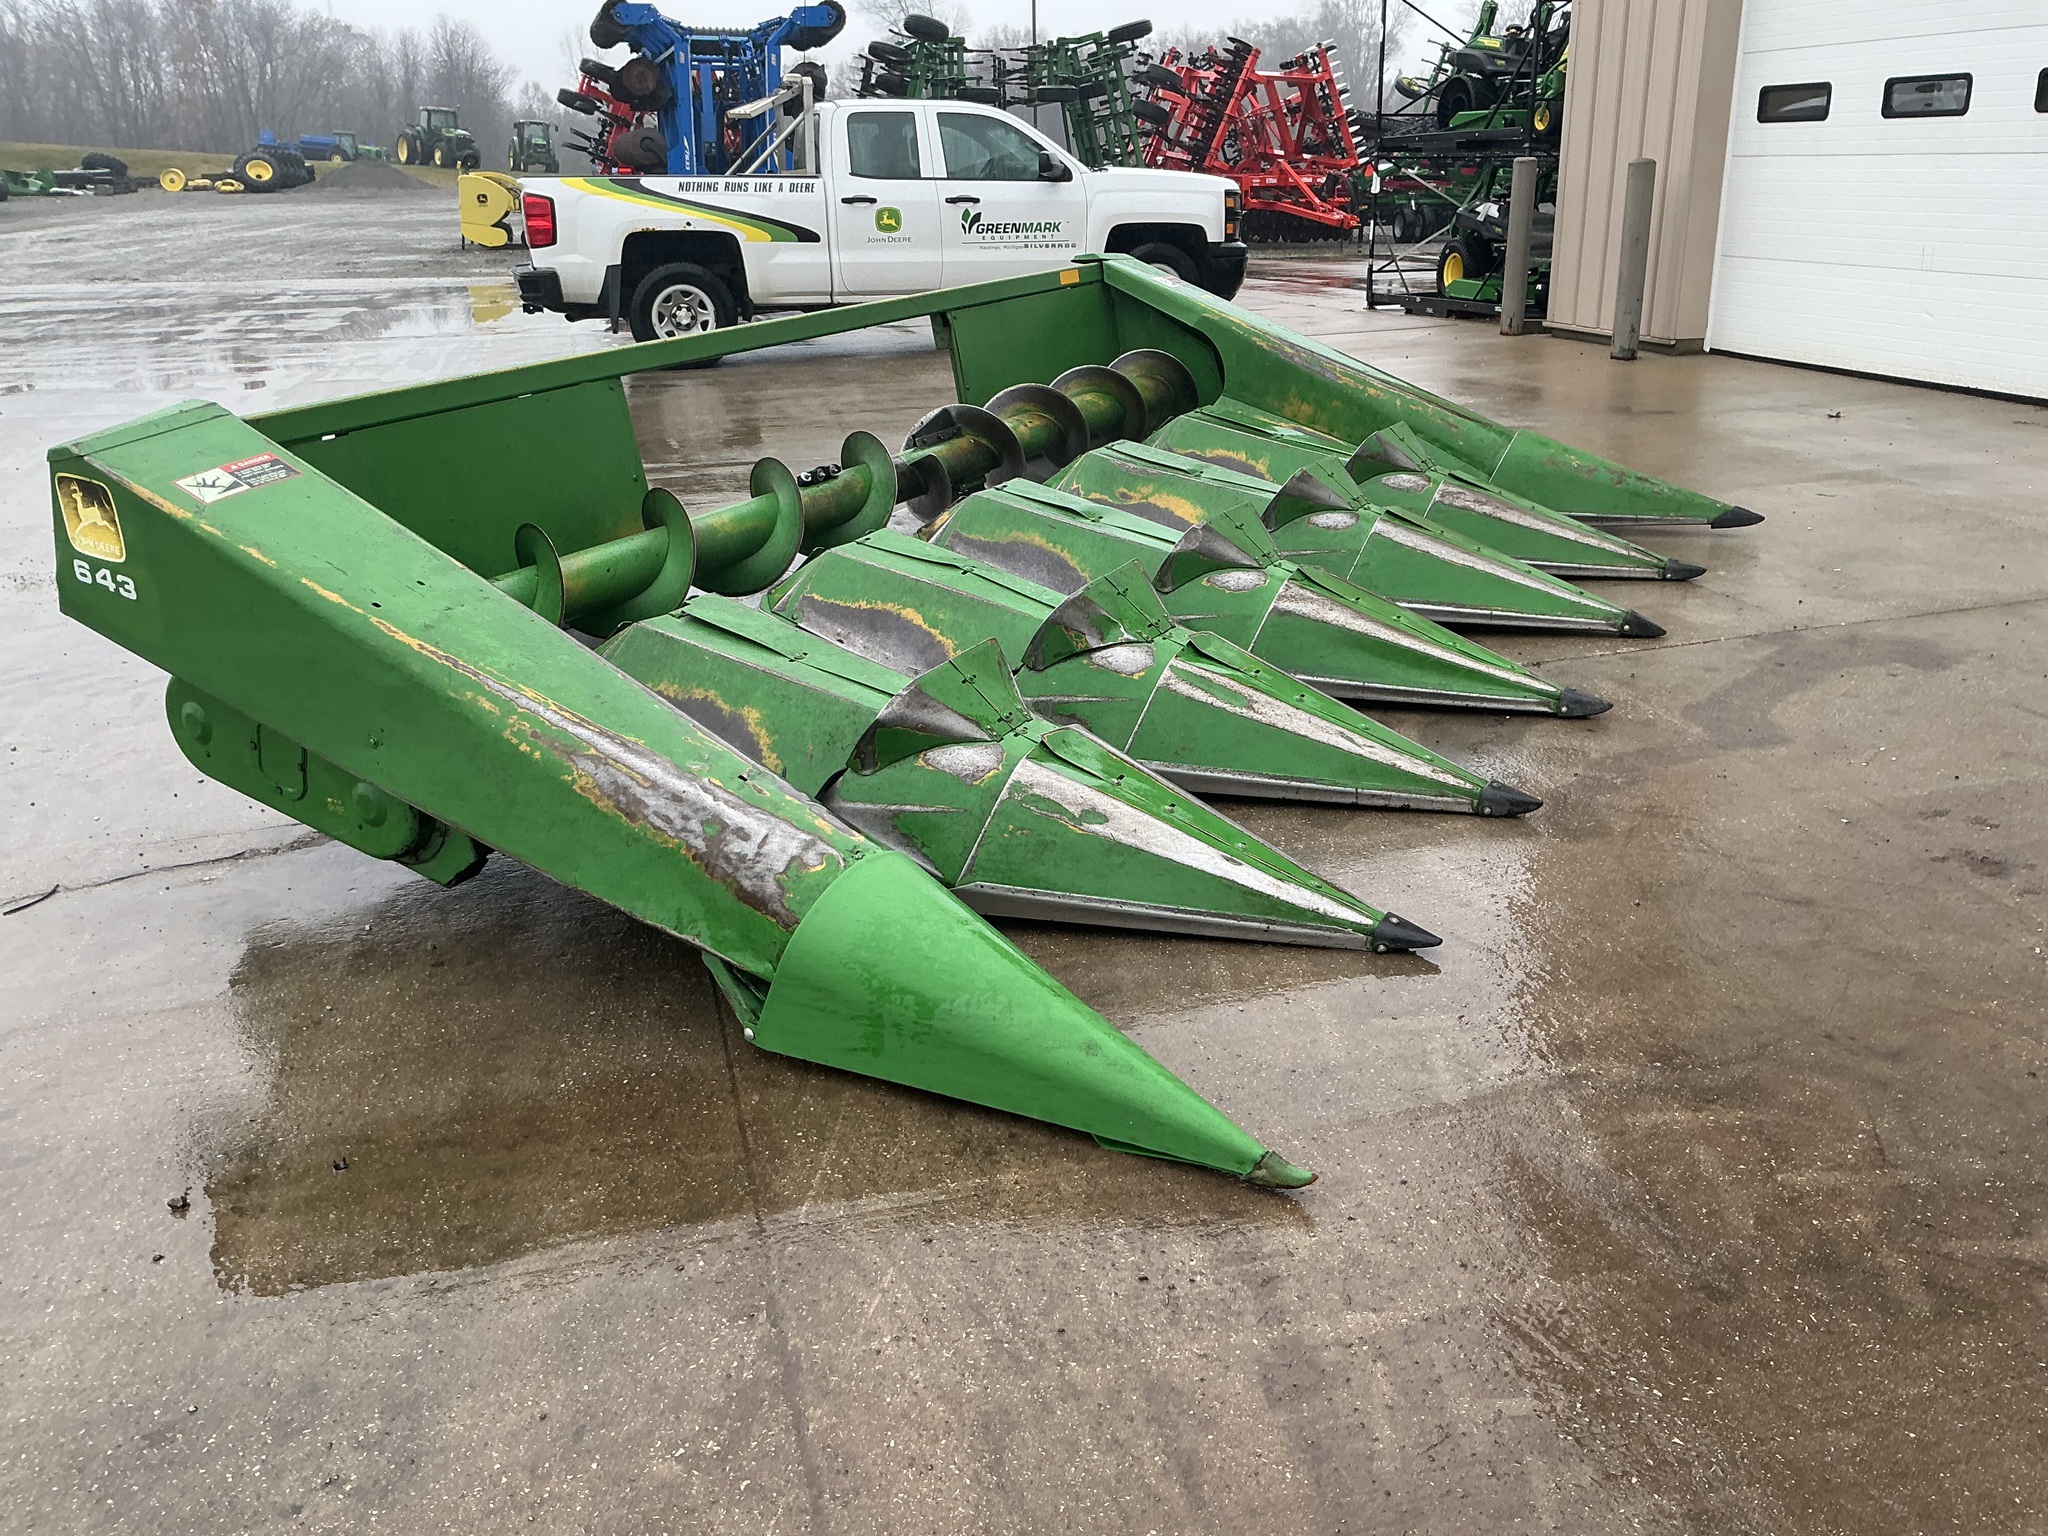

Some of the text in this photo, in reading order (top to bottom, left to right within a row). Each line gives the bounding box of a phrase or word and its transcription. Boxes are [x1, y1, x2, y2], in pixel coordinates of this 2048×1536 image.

[678, 181, 816, 193] NOTHING RUNS LIKE A DEERE
[975, 221, 1062, 235] GREENMARK
[866, 235, 912, 244] JOHN DEERE
[237, 454, 271, 468] DANGER
[74, 535, 121, 556] JOHN DEERE
[73, 558, 137, 600] 643
